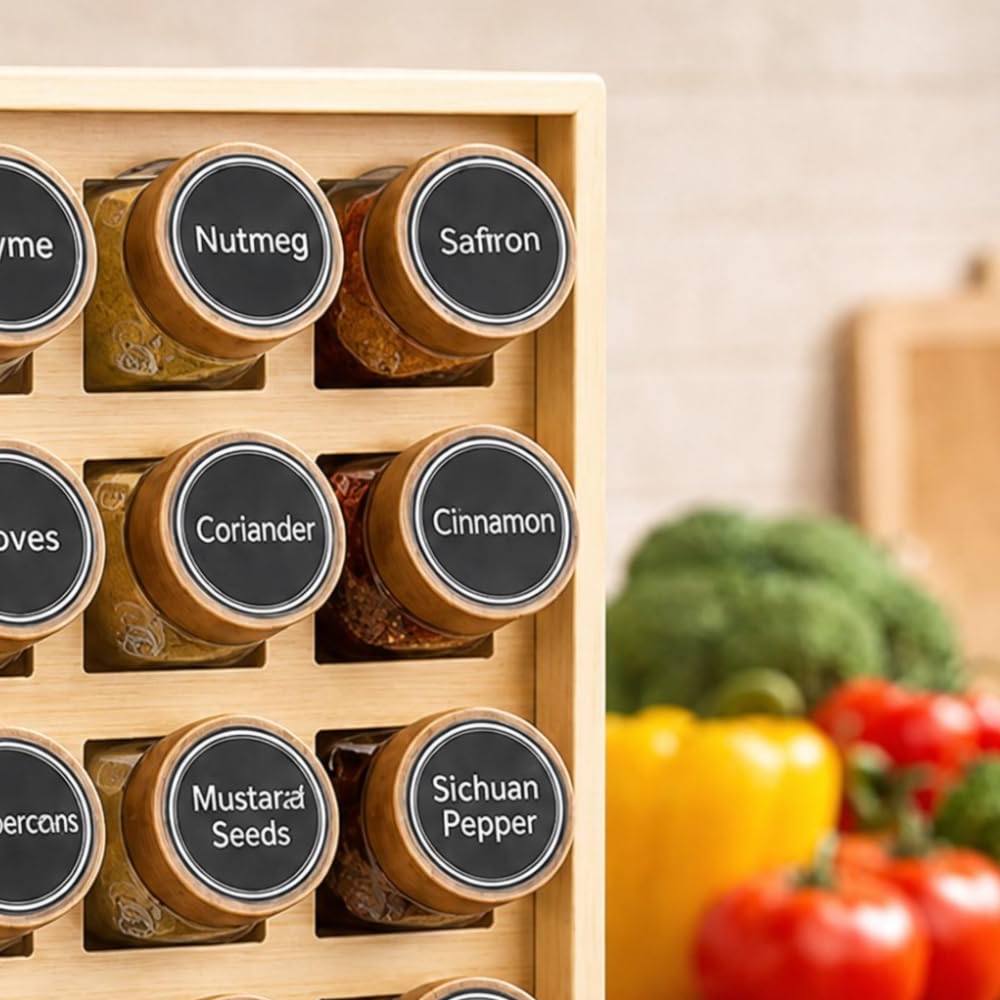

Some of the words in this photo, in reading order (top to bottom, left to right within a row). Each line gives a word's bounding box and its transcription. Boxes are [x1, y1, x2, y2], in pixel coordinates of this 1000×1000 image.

[195, 225, 308, 261] Nutmeg
[196, 514, 316, 543] Coriander
[433, 507, 556, 535] Cinnamon
[433, 774, 539, 802] Sichuan
[212, 820, 291, 848] Seeds
[443, 810, 537, 843] Pepper
